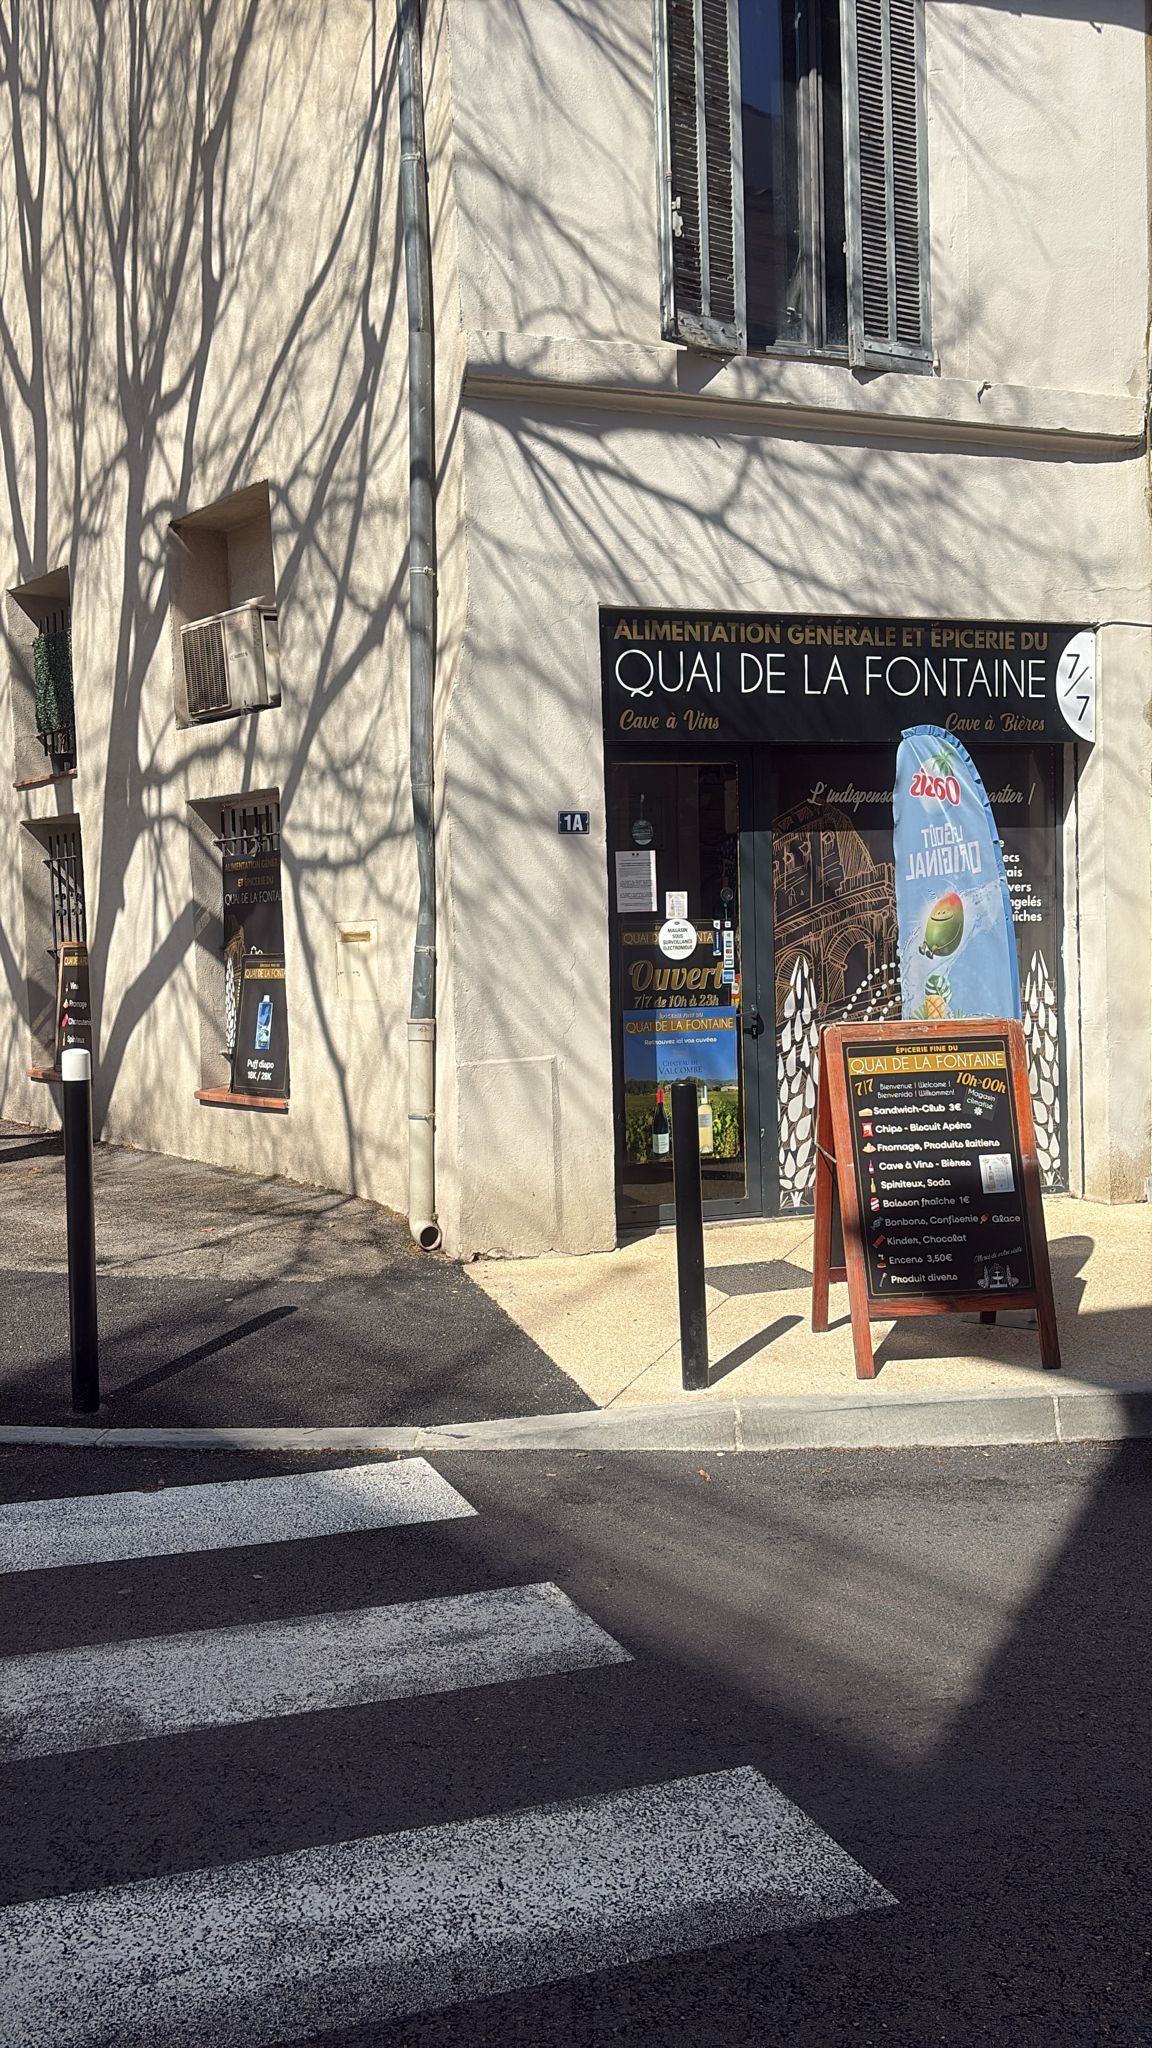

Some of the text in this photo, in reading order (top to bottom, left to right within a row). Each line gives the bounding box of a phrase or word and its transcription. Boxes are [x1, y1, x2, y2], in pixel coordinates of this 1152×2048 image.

[614, 619, 1048, 650] ALIMENTATION GÉNÉRALE ET ÉPICERIE DU
[615, 649, 1046, 698] QUAI DE LA FONTAINE
[619, 708, 720, 731] Cave à Vins
[945, 712, 1045, 732] Cave à Bières
[807, 780, 893, 813] L'indispensa
[564, 814, 583, 831] 1A
[1002, 854, 1020, 862] ecs
[629, 960, 724, 992] Ouvert
[655, 995, 667, 1008] de
[668, 994, 687, 1008] 10h
[689, 994, 698, 1006] à
[699, 993, 720, 1007] 23h
[625, 1017, 735, 1034] QUAI DE LA FONTAINE
[895, 1044, 959, 1054] ÉPICERIE FINE DU
[658, 1065, 703, 1075] VALCOMBE
[850, 1052, 1004, 1075] QUAI DE LA FONTAINE
[879, 1083, 913, 1091] Bienvenue
[918, 1081, 947, 1089] Welcome
[877, 1090, 913, 1099] Bienvenido
[968, 1088, 996, 1102] Magasin
[873, 1104, 962, 1116] Sandwich-Club 3€
[875, 1124, 903, 1134] Chips
[910, 1122, 941, 1133] Biscuit
[942, 1121, 972, 1132] Apéro
[877, 1139, 1001, 1154] Fromage, Produits laitiers
[879, 1161, 904, 1171] Cave
[905, 1160, 912, 1170] à
[913, 1159, 934, 1169] Vins
[941, 1158, 972, 1168] Bières
[881, 1178, 951, 1191] Spiriteux, Soda
[883, 1196, 971, 1209] Boisson fraîche 1€
[885, 1214, 1021, 1228] Bonbons, Confiserie Glace
[887, 1233, 967, 1246] Kinder, Chocolat
[889, 1253, 953, 1265] Encens 3,50€
[891, 1272, 958, 1285] Produit divers
